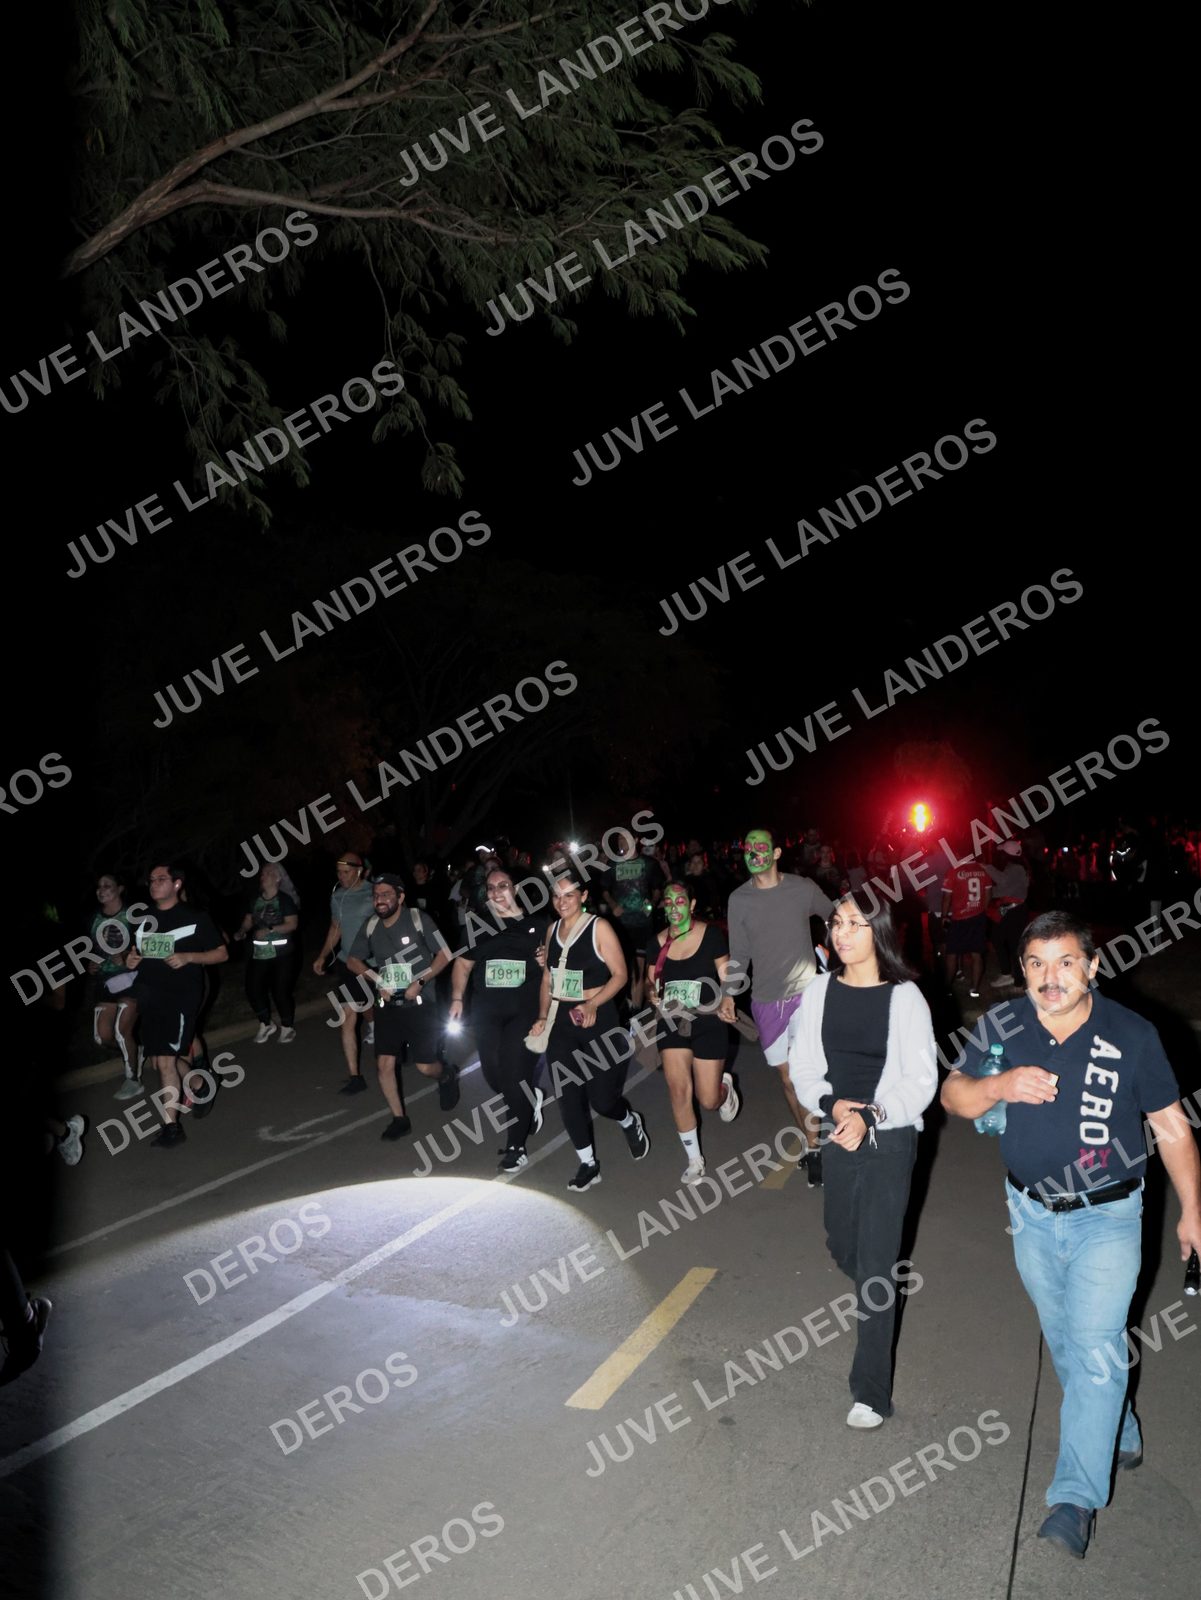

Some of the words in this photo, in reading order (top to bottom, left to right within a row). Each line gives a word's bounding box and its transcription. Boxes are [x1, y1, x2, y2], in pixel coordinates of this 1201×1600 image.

[968, 878, 981, 901] 9
[143, 941, 171, 952] 1378
[490, 968, 520, 980] 1981
[1080, 1035, 1122, 1145] AERO
[1079, 1148, 1111, 1168] NY
